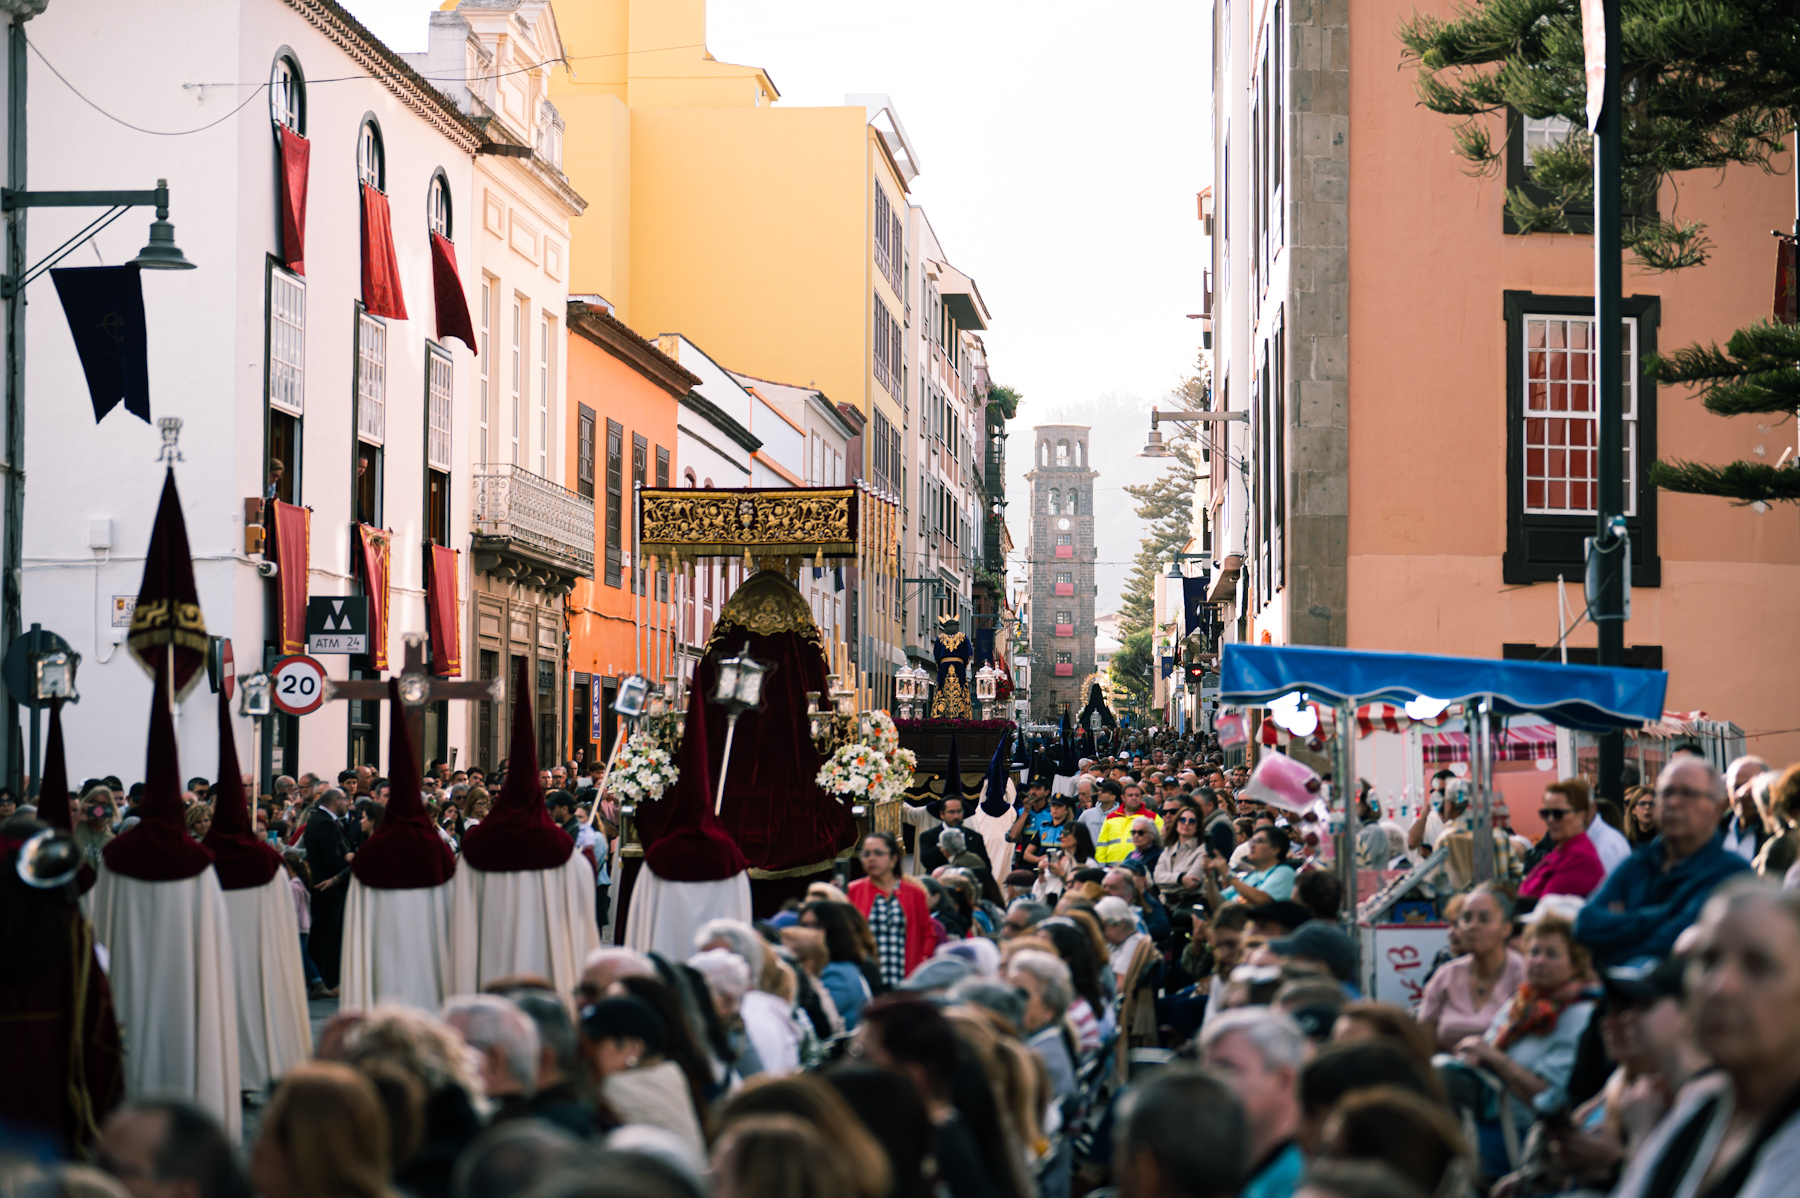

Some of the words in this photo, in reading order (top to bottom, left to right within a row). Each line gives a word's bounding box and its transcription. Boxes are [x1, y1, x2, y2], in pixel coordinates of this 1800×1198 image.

[315, 638, 339, 648] ATM
[347, 636, 360, 647] 24
[282, 675, 315, 695] 20
